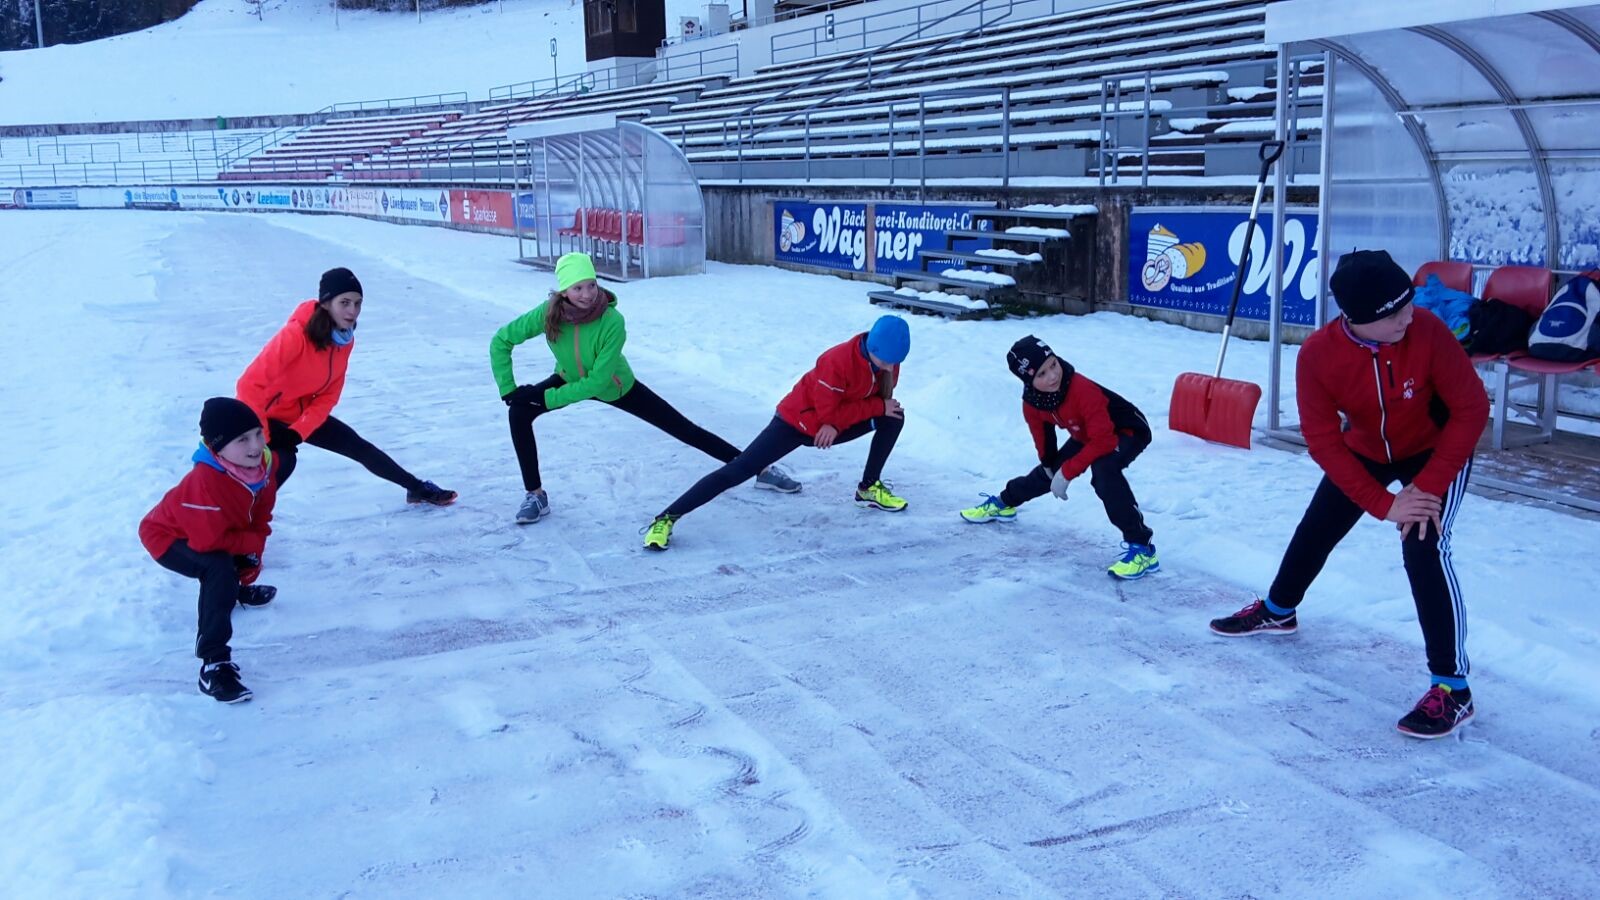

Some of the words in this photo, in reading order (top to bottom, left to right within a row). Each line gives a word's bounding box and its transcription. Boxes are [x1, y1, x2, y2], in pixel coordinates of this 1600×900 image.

[1155, 120, 1161, 131] 2
[473, 206, 497, 223] Sparkasse
[812, 206, 922, 270] Wagner
[1170, 282, 1193, 294] Qualität
[1194, 285, 1205, 293] aus
